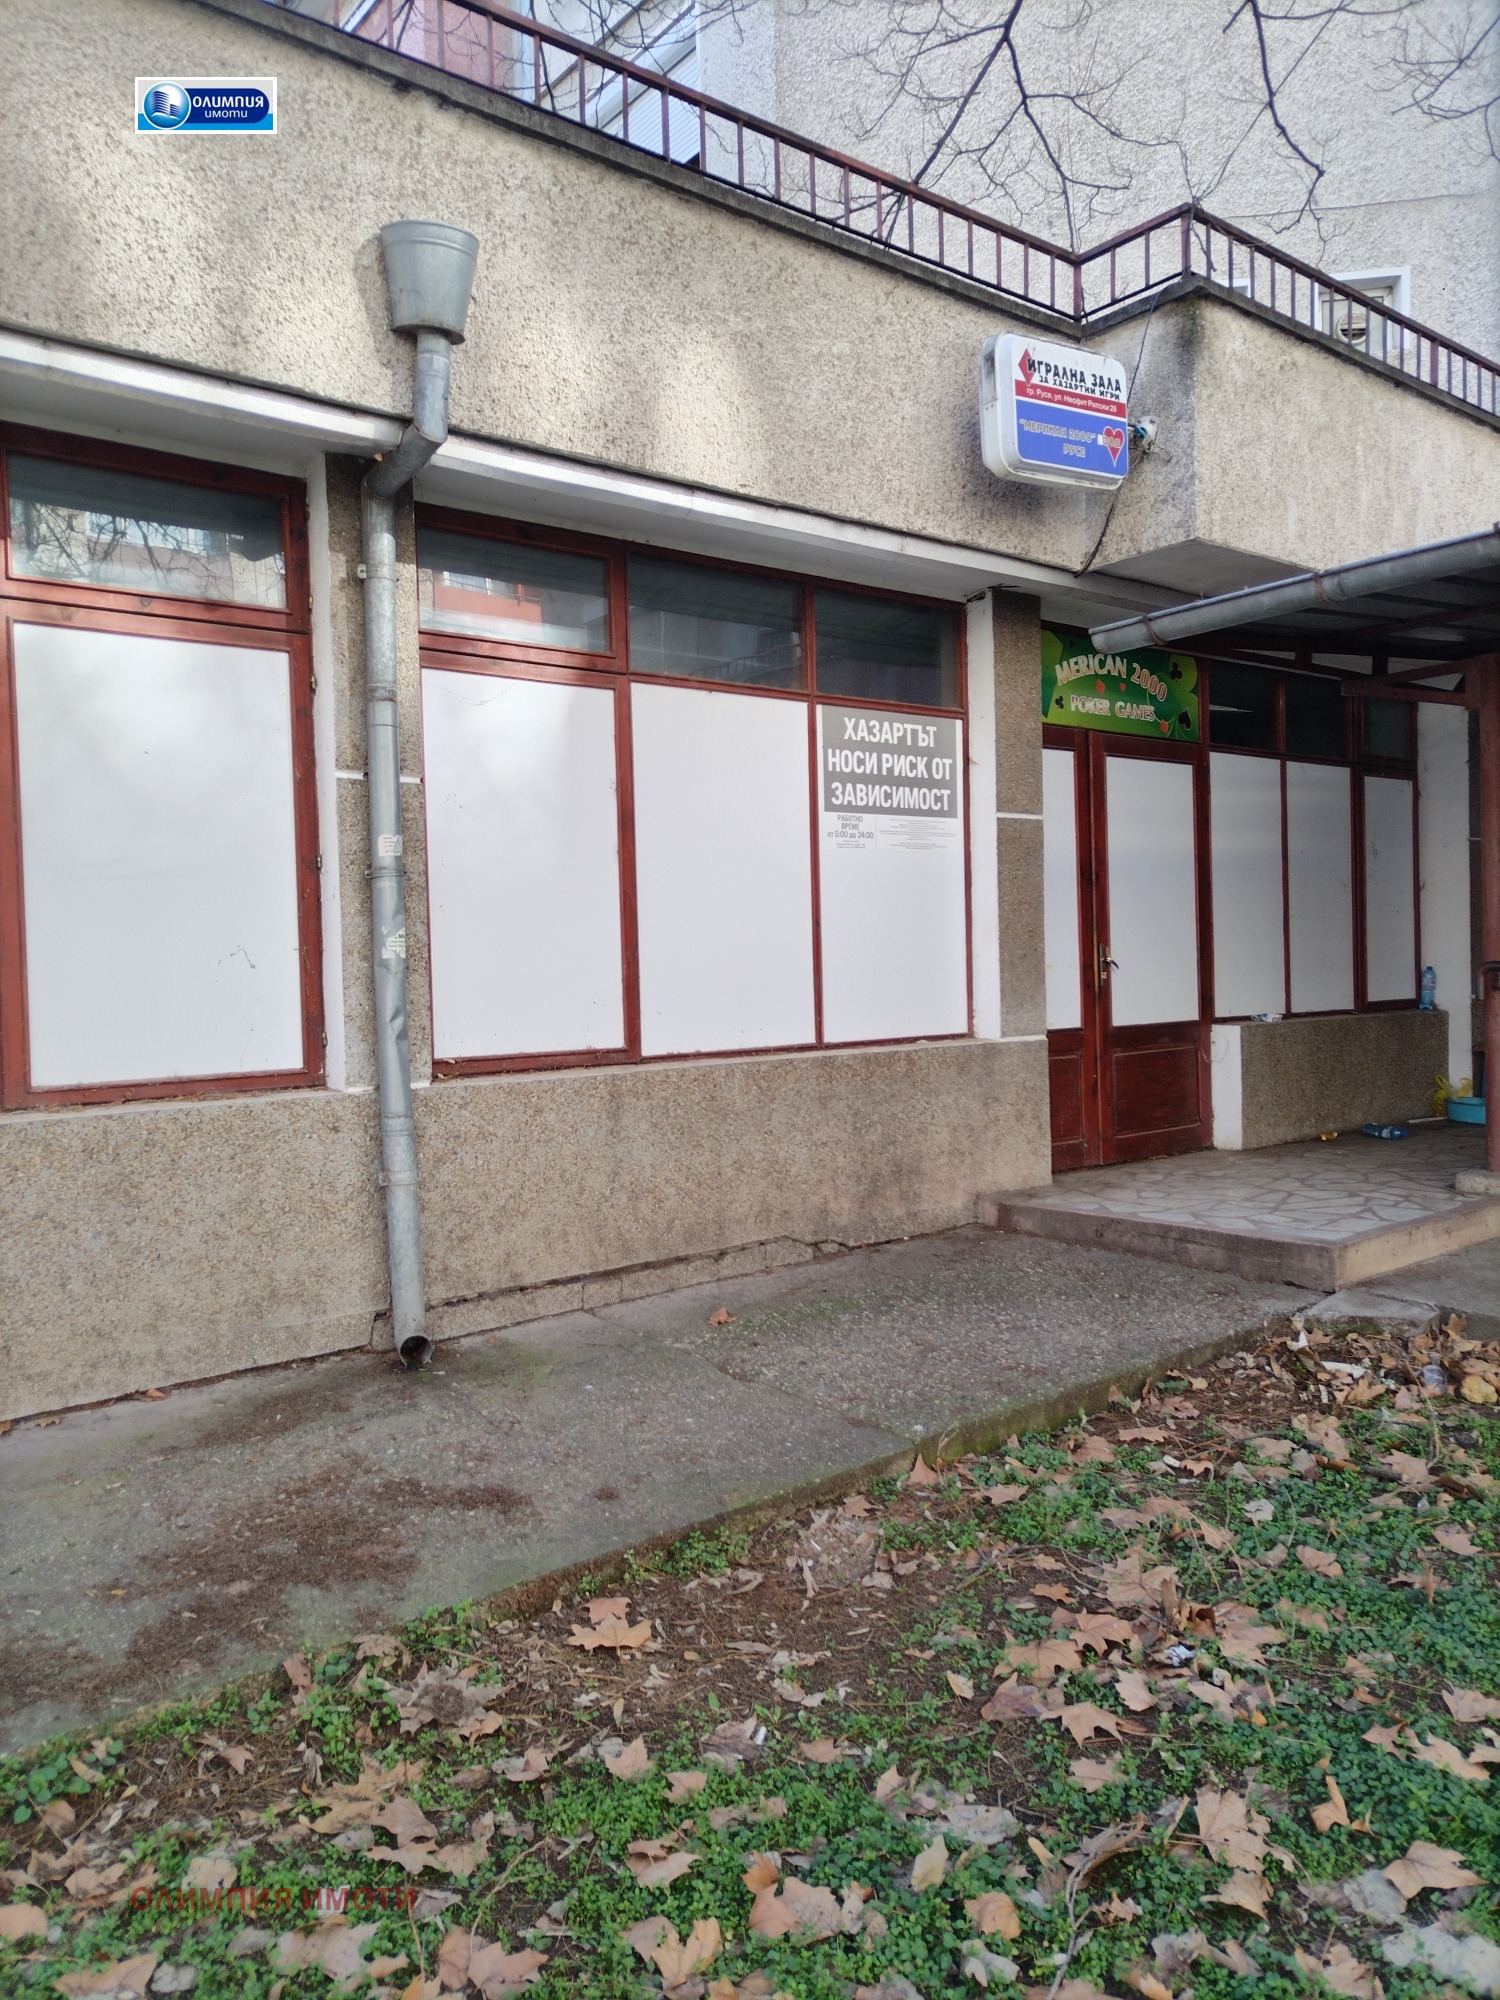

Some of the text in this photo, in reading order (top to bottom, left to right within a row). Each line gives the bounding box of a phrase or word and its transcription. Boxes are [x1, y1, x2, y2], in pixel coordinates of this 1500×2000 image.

[1027, 357, 1122, 393] ИГРАЛНА ЗАЛА
[1039, 375, 1120, 400] ЗА ХАЗАРТНИ ИГРИ
[1026, 388, 1035, 396] гр.
[1064, 394, 1088, 407] Неофит
[1063, 443, 1086, 457] РУСЕ
[1055, 654, 1168, 701] MERICAN 2000
[1070, 695, 1156, 721] POKER GAMES
[843, 717, 937, 748] ХАЗАРТЪТ
[827, 748, 953, 780] НОСИ РИСК ОТ
[831, 781, 951, 811] ЗАВИСИМОСТ
[837, 814, 864, 822] РАБОТНО
[841, 822, 860, 830] ВРЕМЕ
[857, 831, 874, 839] 24:00
